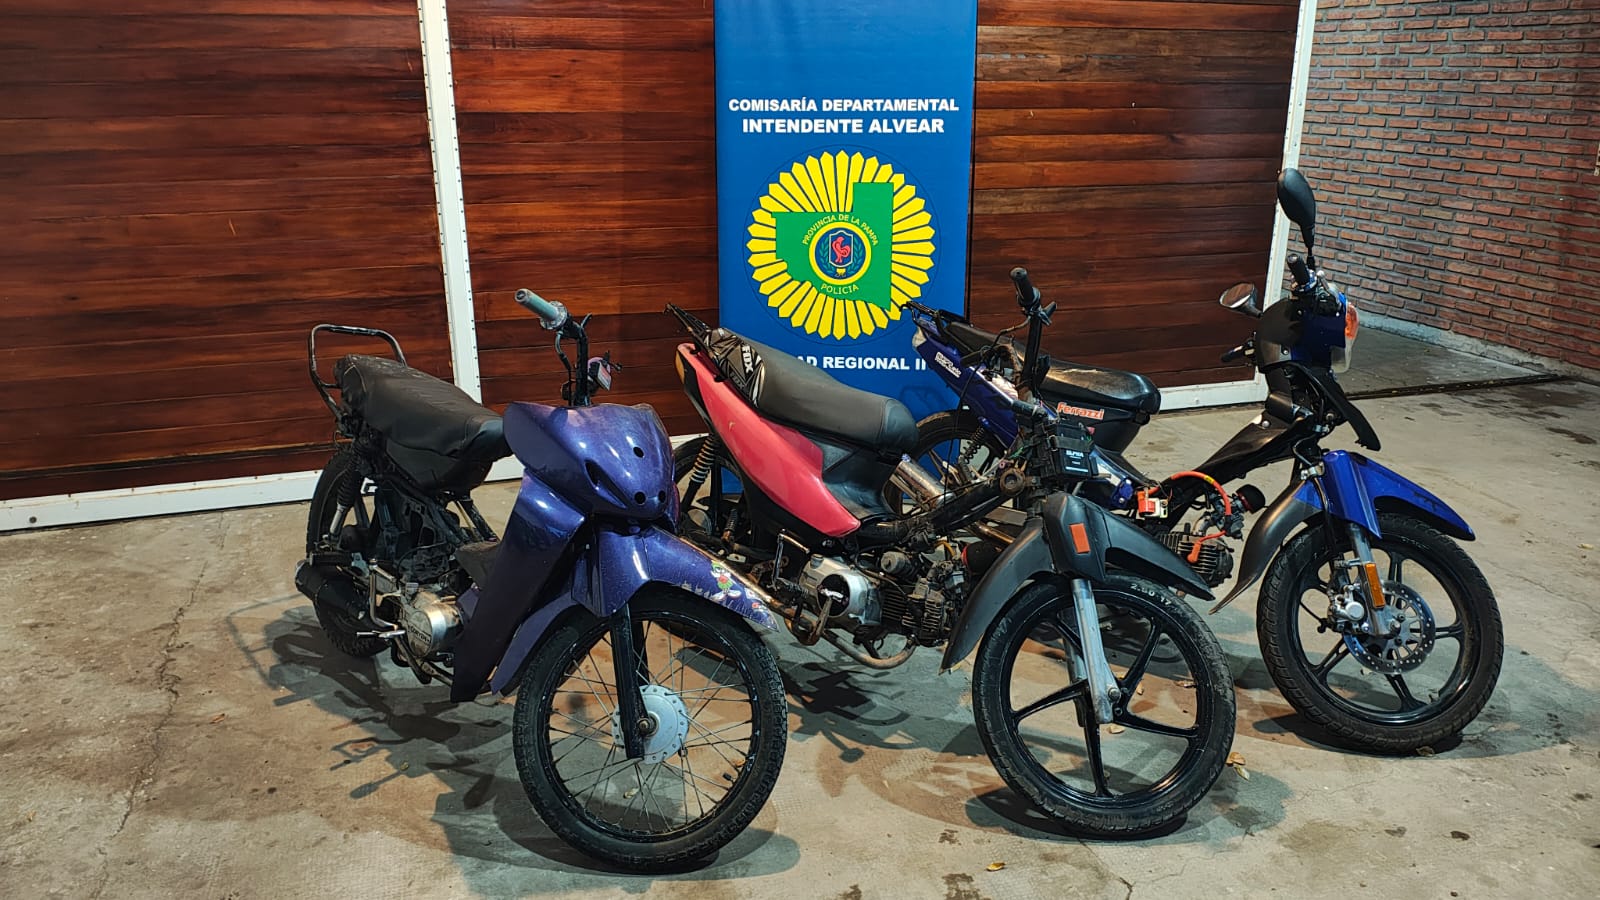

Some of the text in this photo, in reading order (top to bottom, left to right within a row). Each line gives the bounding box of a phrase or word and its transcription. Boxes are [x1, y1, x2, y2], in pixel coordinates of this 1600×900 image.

[728, 97, 960, 112] COMISARÍA DEPARTAMENTAL
[742, 118, 945, 133] INTENDENTE ALVEAR
[802, 213, 879, 246] PROVINCIA DE LA PAMPA
[821, 283, 859, 295] POLICIA
[823, 356, 910, 370] REGIONAL
[1057, 402, 1105, 420] Ferrazzi
